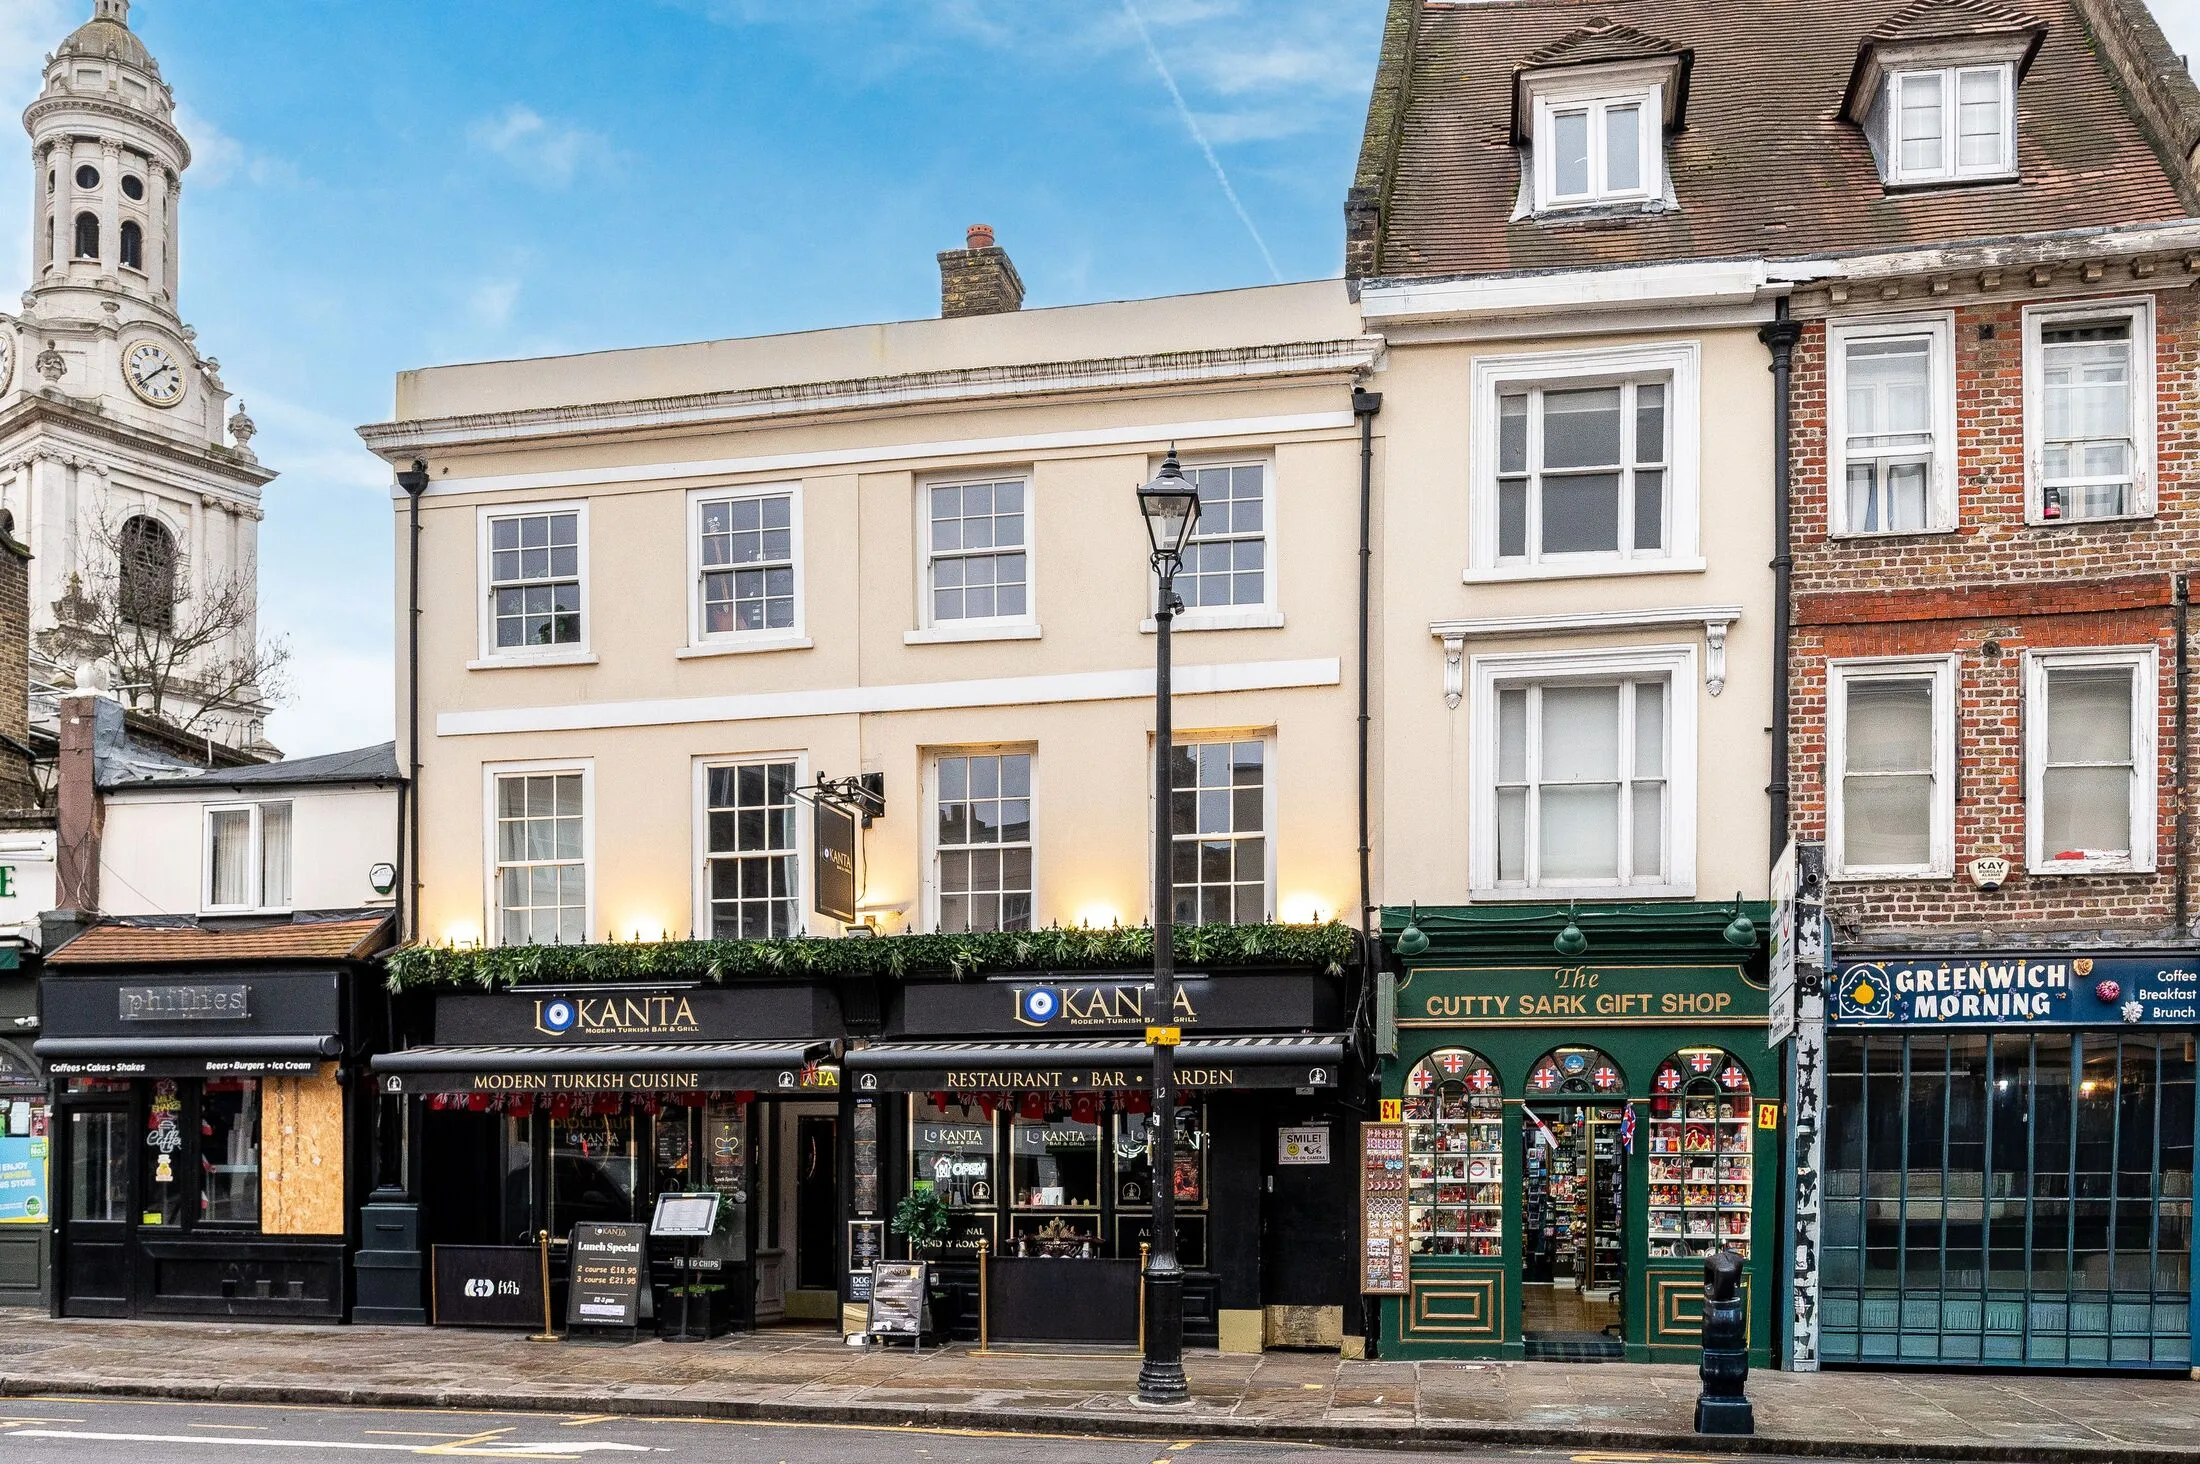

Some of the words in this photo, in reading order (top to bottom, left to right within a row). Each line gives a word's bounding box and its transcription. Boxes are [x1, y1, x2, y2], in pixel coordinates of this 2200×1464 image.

[1555, 965, 1600, 989] The
[1895, 963, 2066, 993] GREENWICH
[2157, 971, 2197, 981] Coffee
[2139, 988, 2197, 1000] Breakfast
[126, 987, 243, 1018] phillies
[1012, 984, 1197, 1027] LOKANA
[1426, 995, 1510, 1016] CUTTY
[1519, 994, 1587, 1014] SARK
[1595, 993, 1653, 1014] GIFT
[1661, 992, 1731, 1013] SHOP
[1914, 993, 2051, 1018] MORNING
[534, 996, 699, 1036] LOKANTA
[2152, 1006, 2196, 1018] Brunch
[617, 1026, 650, 1034] TURKISH
[50, 1063, 81, 1072] Coffees
[86, 1063, 111, 1072] Cakes
[116, 1063, 145, 1072] Shakes
[206, 1061, 229, 1070] Beers
[234, 1061, 265, 1071] Burgers
[272, 1061, 284, 1070] Ice
[284, 1061, 311, 1070] Cream
[474, 1074, 549, 1089] MODERN
[552, 1073, 625, 1088] TURKISH
[629, 1072, 699, 1088] CUISINE
[946, 1071, 1063, 1088] RESTAURANT
[1091, 1071, 1127, 1087] BAR
[1173, 1069, 1234, 1085] ARDEN
[1760, 1107, 1775, 1127] £1
[924, 1128, 982, 1143] LOKANTA
[1026, 1129, 1086, 1144] LOKANTA
[1287, 1134, 1322, 1143] SMILE!
[2, 1161, 28, 1171] ENJOY
[952, 1162, 988, 1176] OPEN
[10, 1178, 37, 1188] STORE
[577, 1241, 606, 1251] Lunch
[606, 1242, 640, 1254] Special
[577, 1265, 583, 1273] 2
[610, 1266, 638, 1274] £18.95
[699, 1260, 719, 1268] CHIPS
[576, 1275, 582, 1283] 3
[608, 1276, 637, 1285] £21.95
